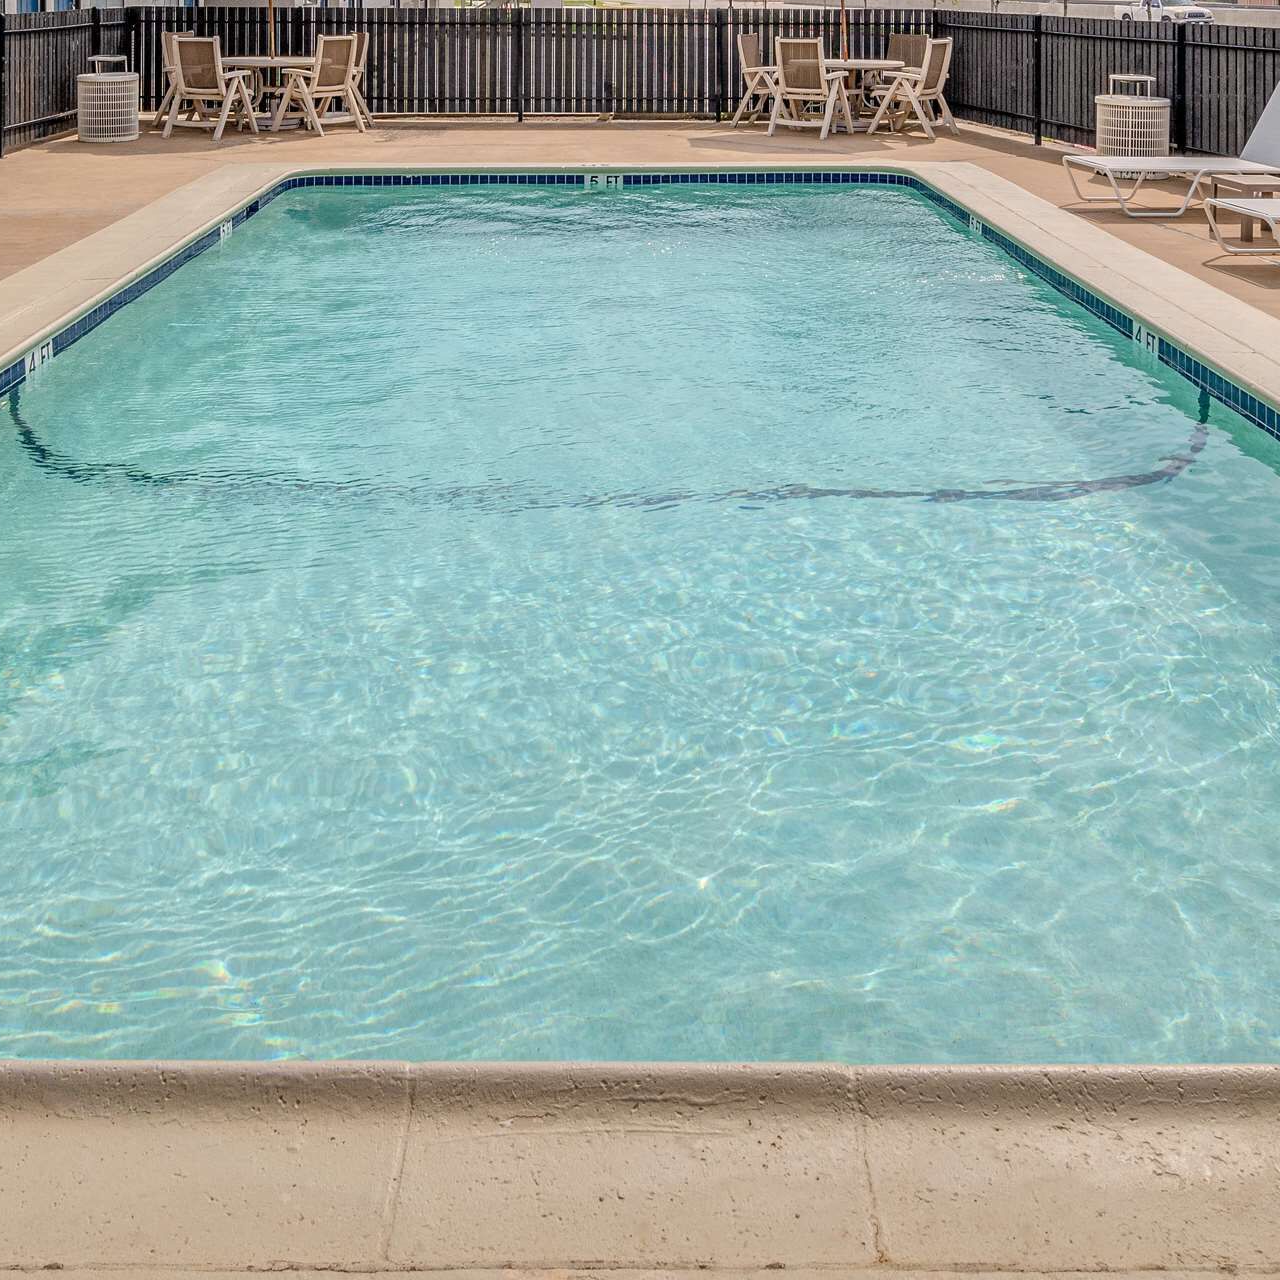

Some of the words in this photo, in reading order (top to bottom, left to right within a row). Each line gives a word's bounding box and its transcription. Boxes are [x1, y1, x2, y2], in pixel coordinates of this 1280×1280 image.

[606, 175, 620, 184] FT
[1135, 324, 1142, 343] 4
[1146, 331, 1156, 353] FT
[28, 351, 36, 373] 4
[41, 341, 50, 364] FT
